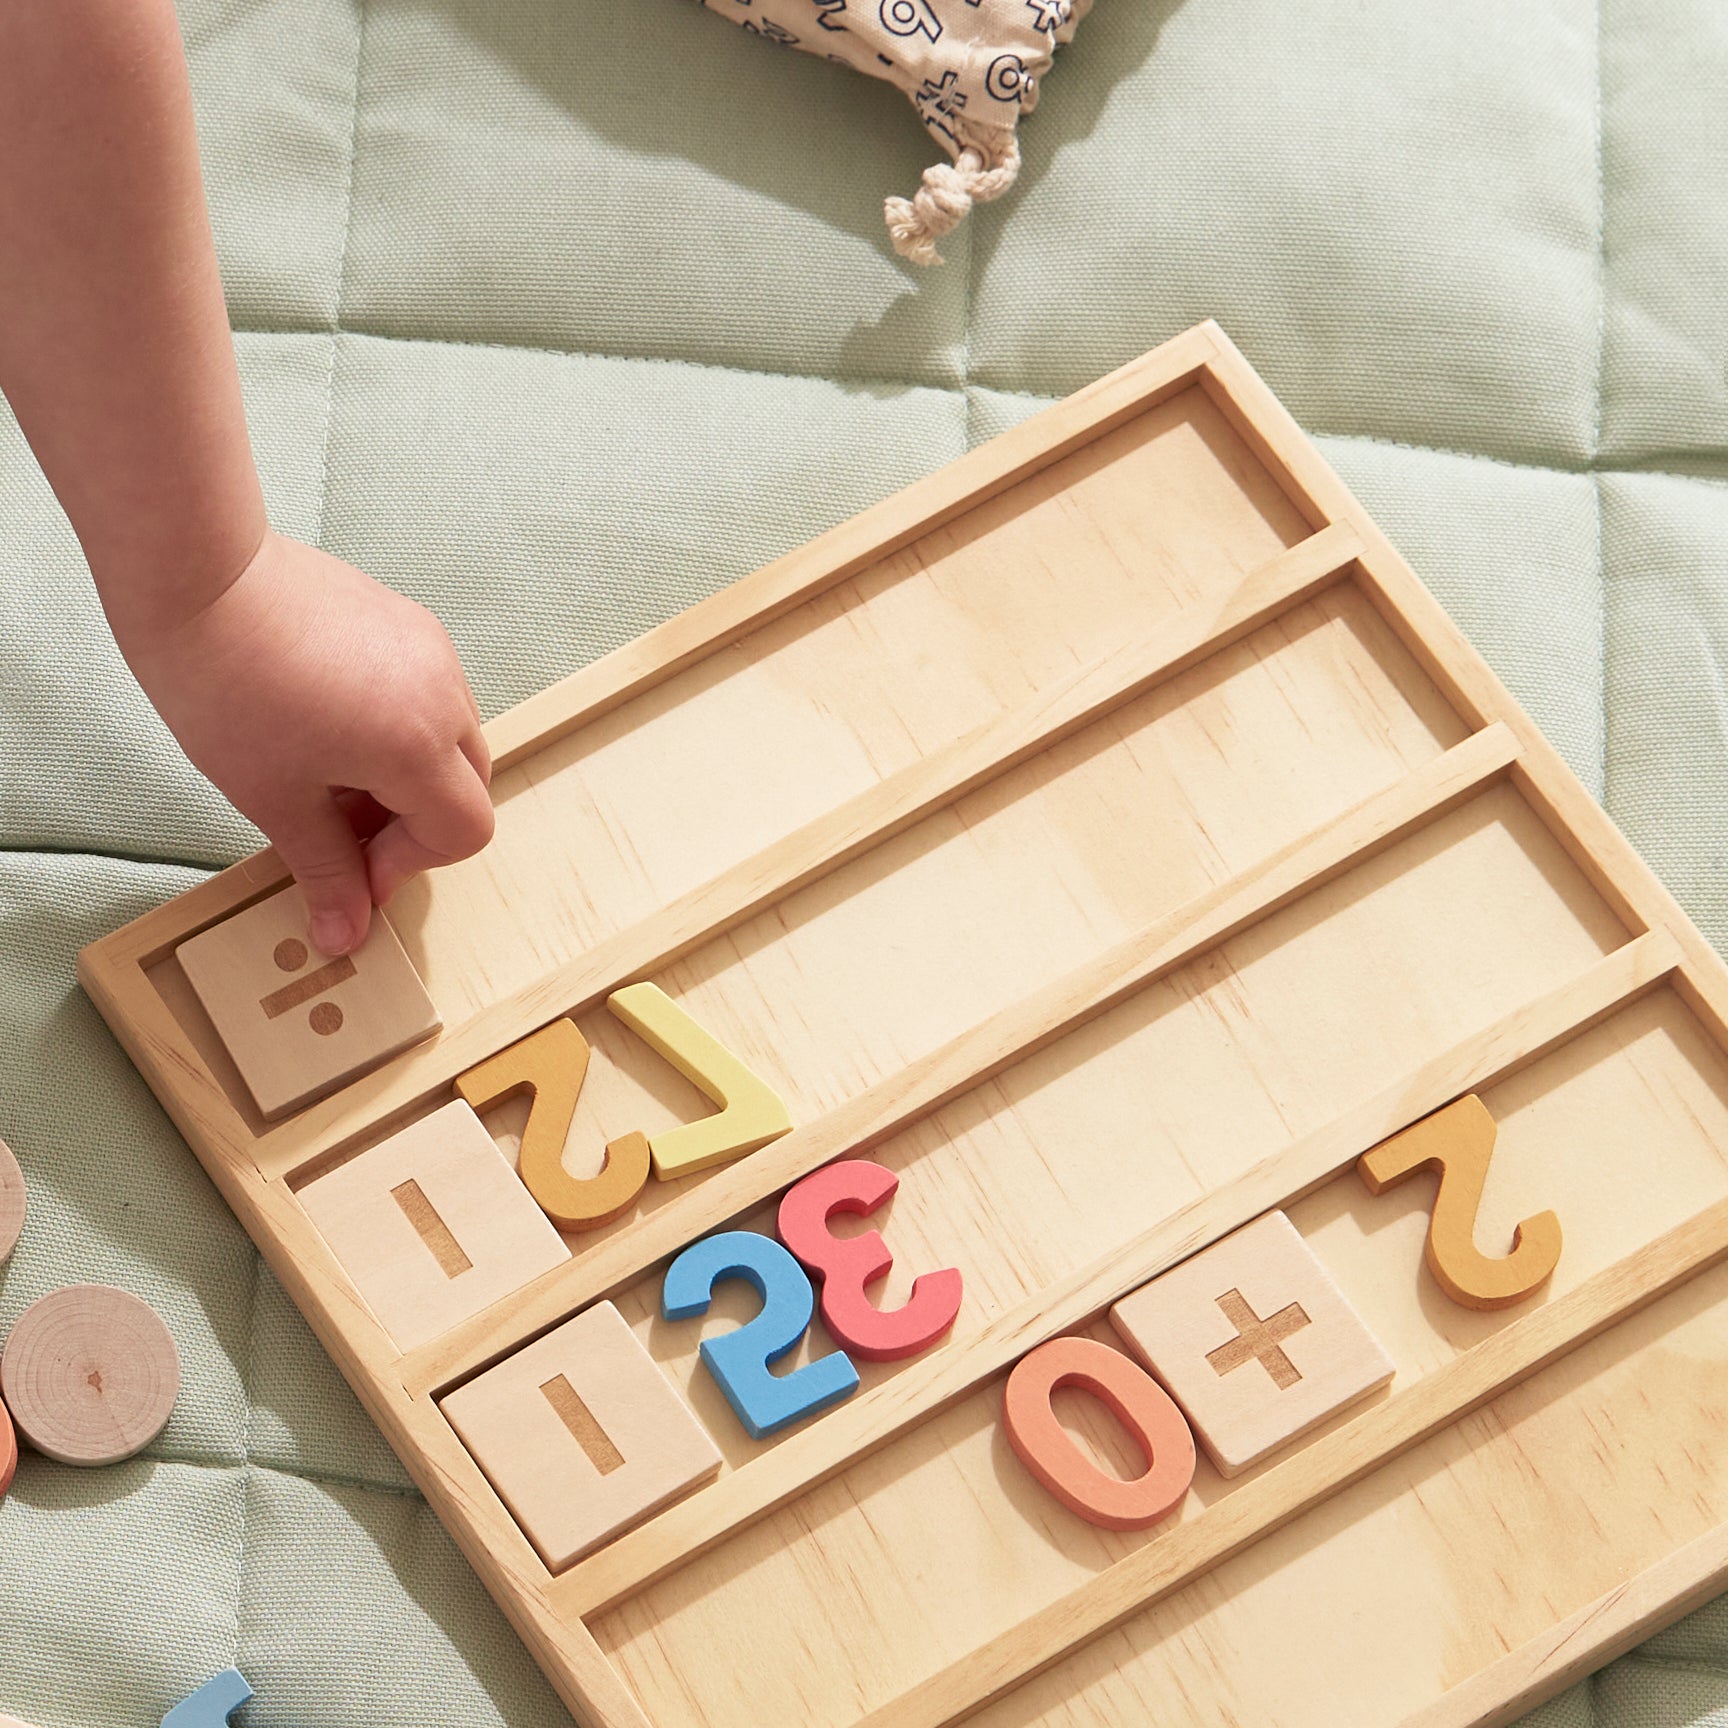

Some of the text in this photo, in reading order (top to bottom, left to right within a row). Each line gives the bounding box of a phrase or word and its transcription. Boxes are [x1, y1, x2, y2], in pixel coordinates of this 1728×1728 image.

[453, 1018, 651, 1234] 2
[778, 1160, 963, 1363] 3
[1002, 1336, 1196, 1533] 0
[1357, 1093, 1563, 1312] 2
